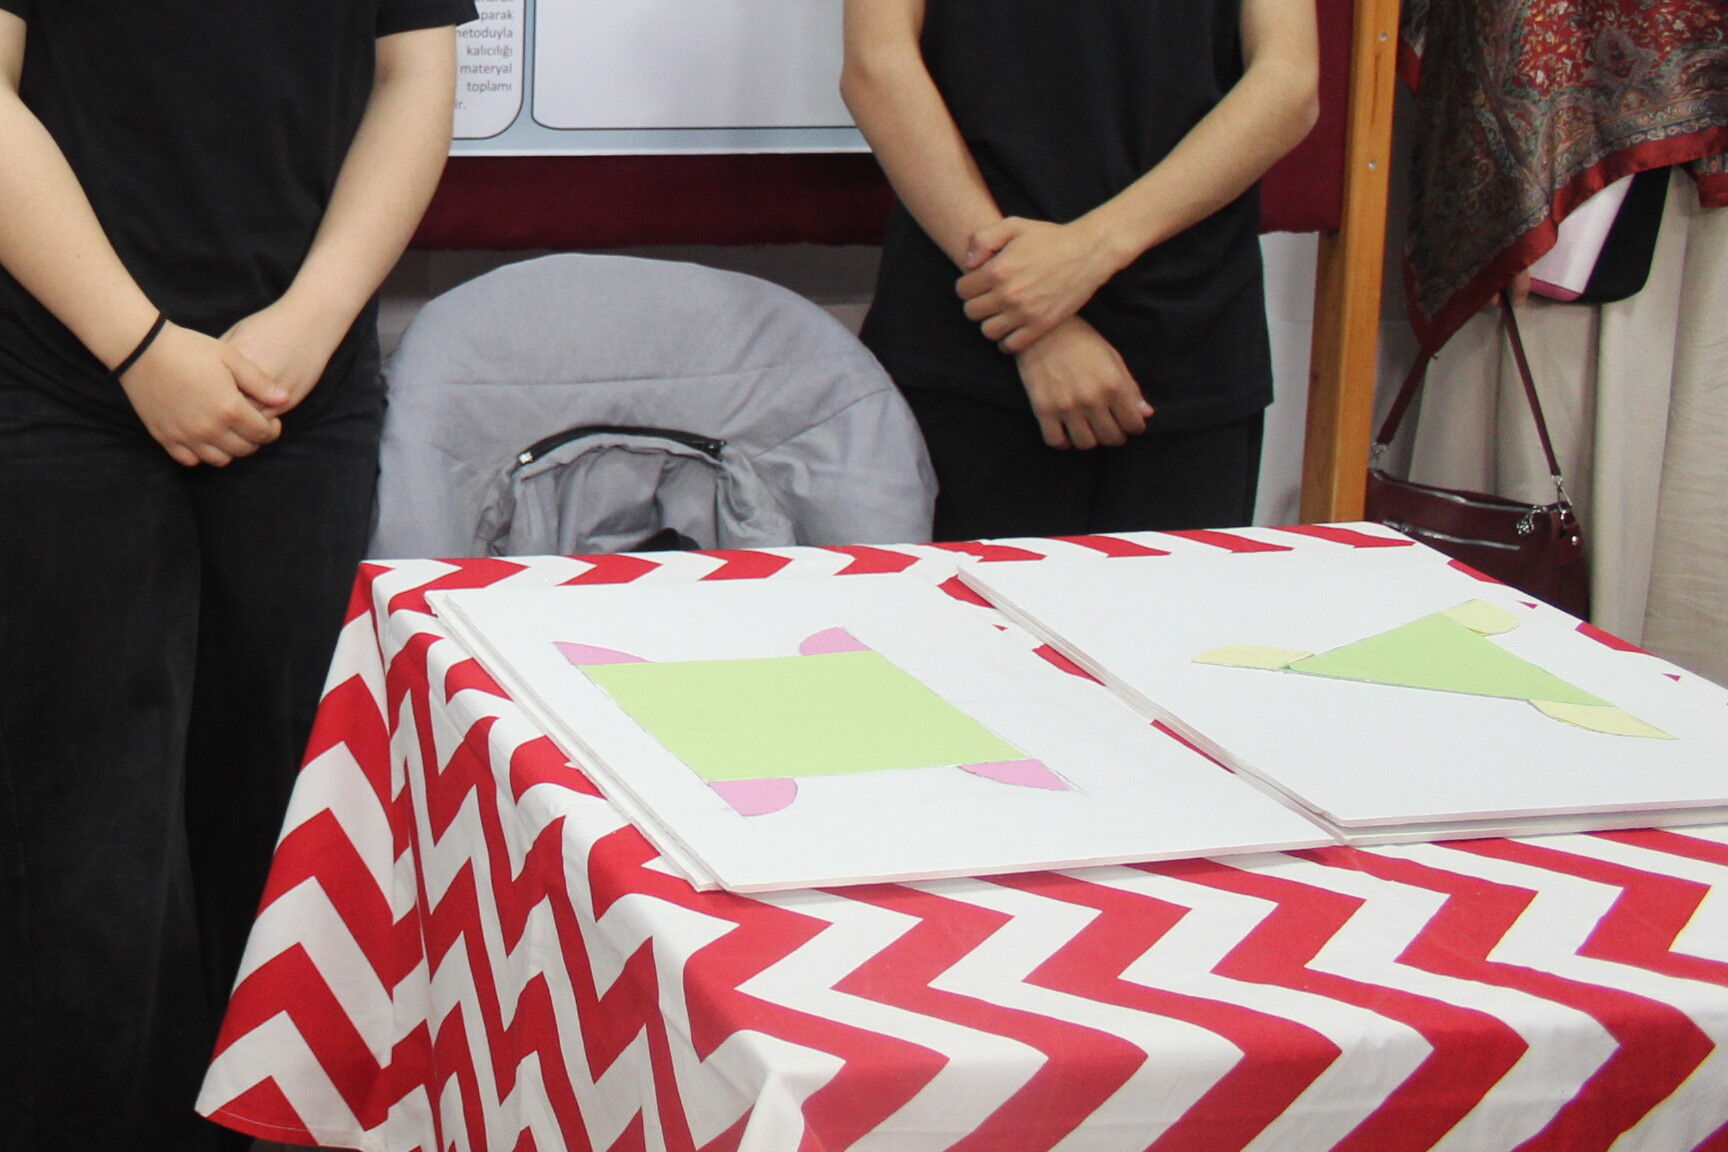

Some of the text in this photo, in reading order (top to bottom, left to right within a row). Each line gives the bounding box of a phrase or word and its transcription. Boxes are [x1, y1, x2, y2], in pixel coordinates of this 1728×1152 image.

[466, 46, 512, 59] kalıcılığı
[459, 63, 512, 76] materyal
[467, 81, 512, 93] toplamı
